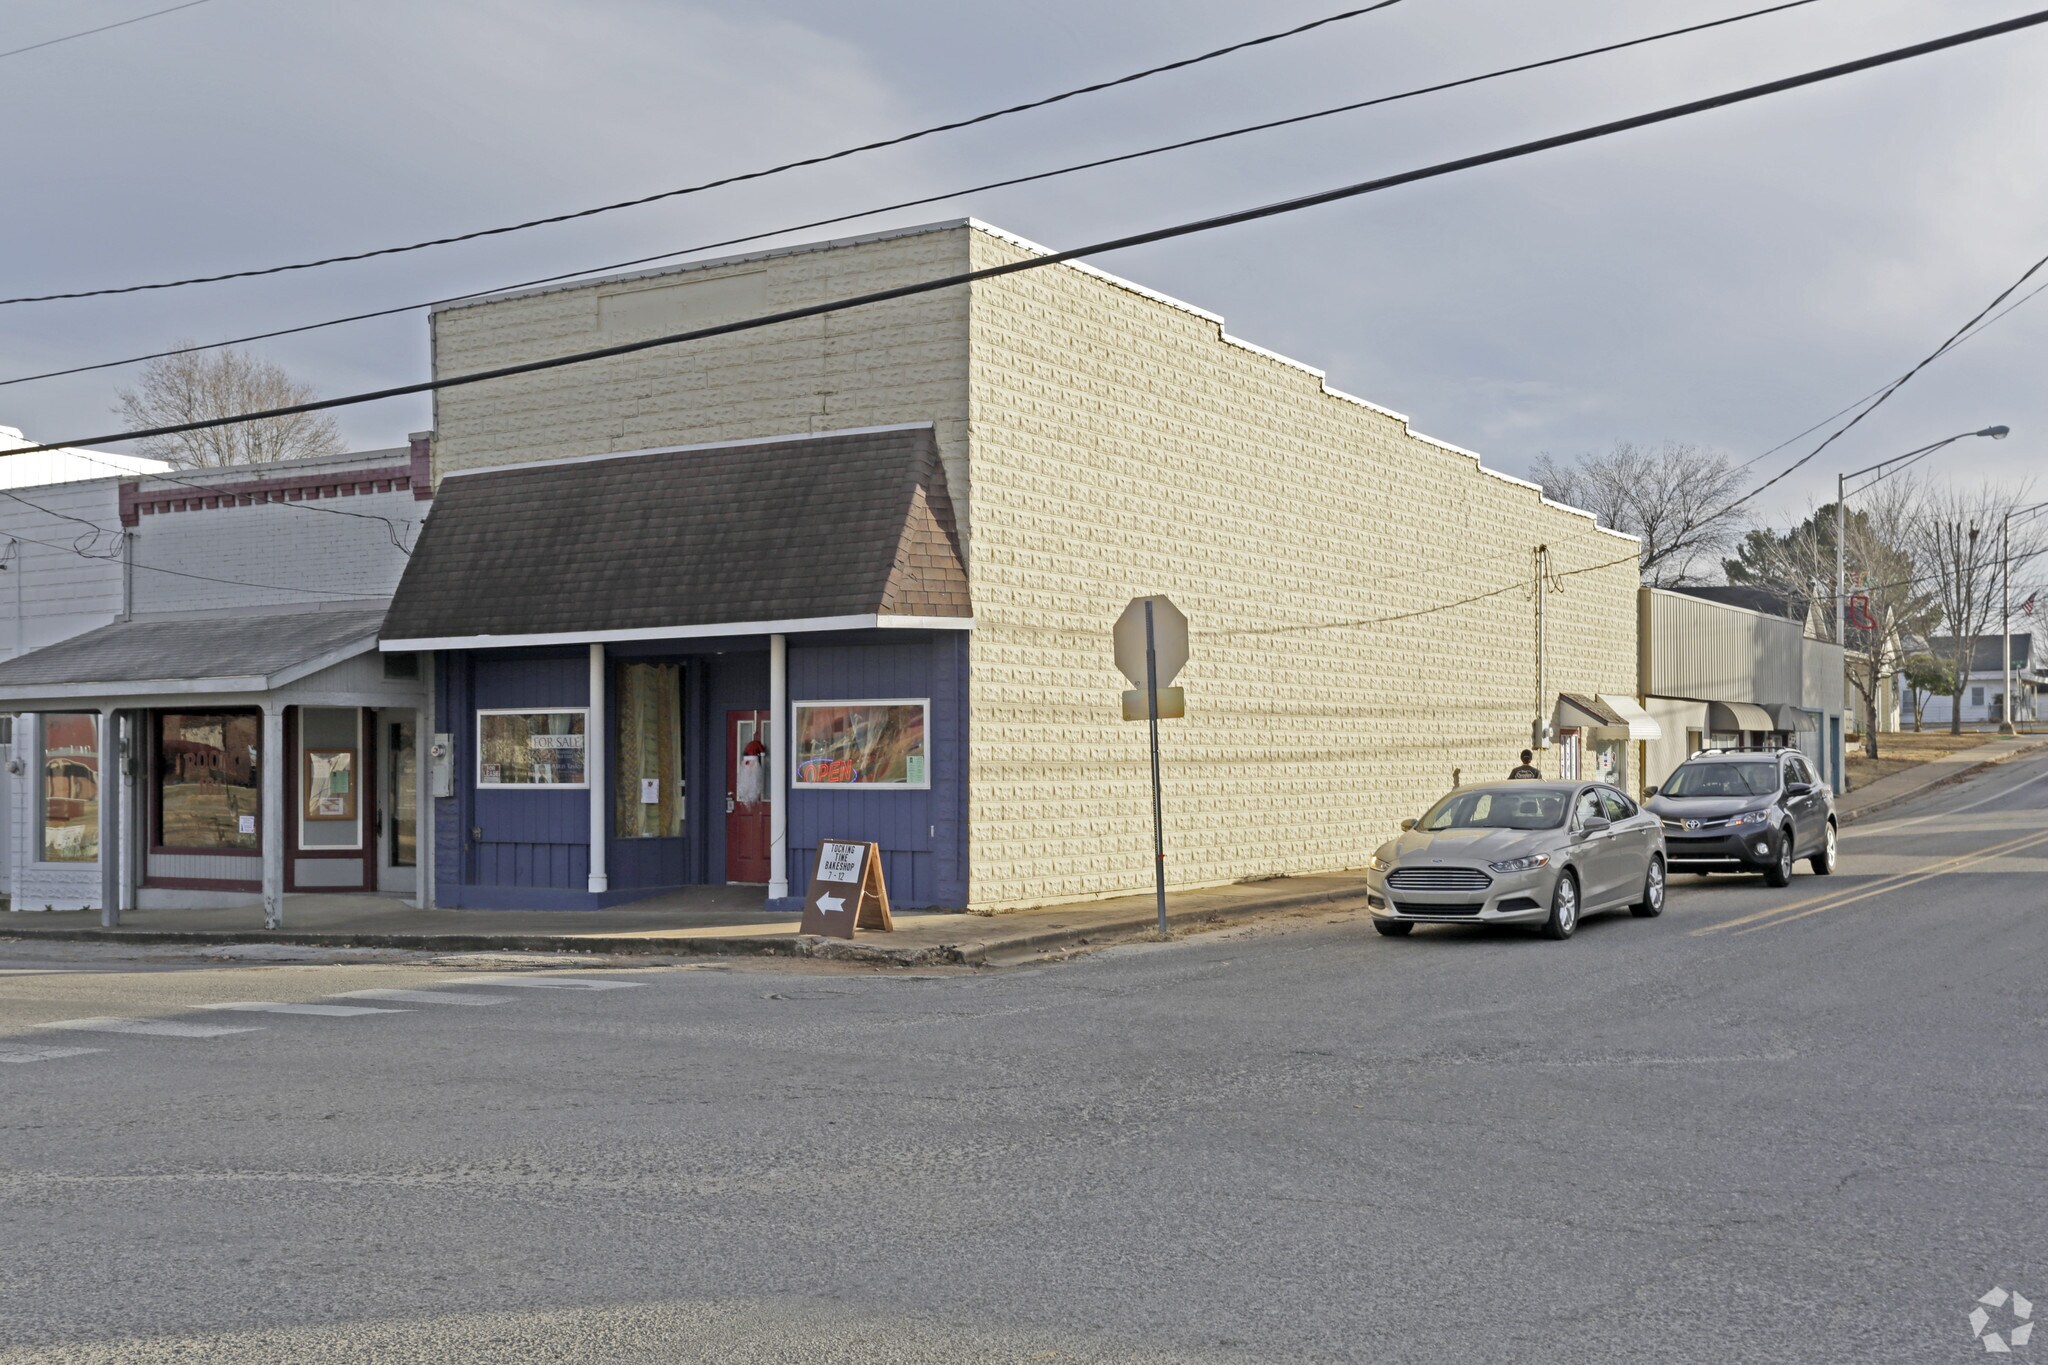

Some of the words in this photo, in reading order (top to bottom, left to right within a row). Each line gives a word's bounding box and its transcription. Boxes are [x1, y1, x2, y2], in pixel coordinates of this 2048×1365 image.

[533, 737, 554, 748] FOR
[556, 737, 580, 748] SALE
[803, 760, 852, 782] OPEN
[831, 844, 855, 853] TOCKING
[825, 861, 854, 871] BAKESHOP
[828, 871, 832, 880] 7
[838, 872, 845, 881] 12
